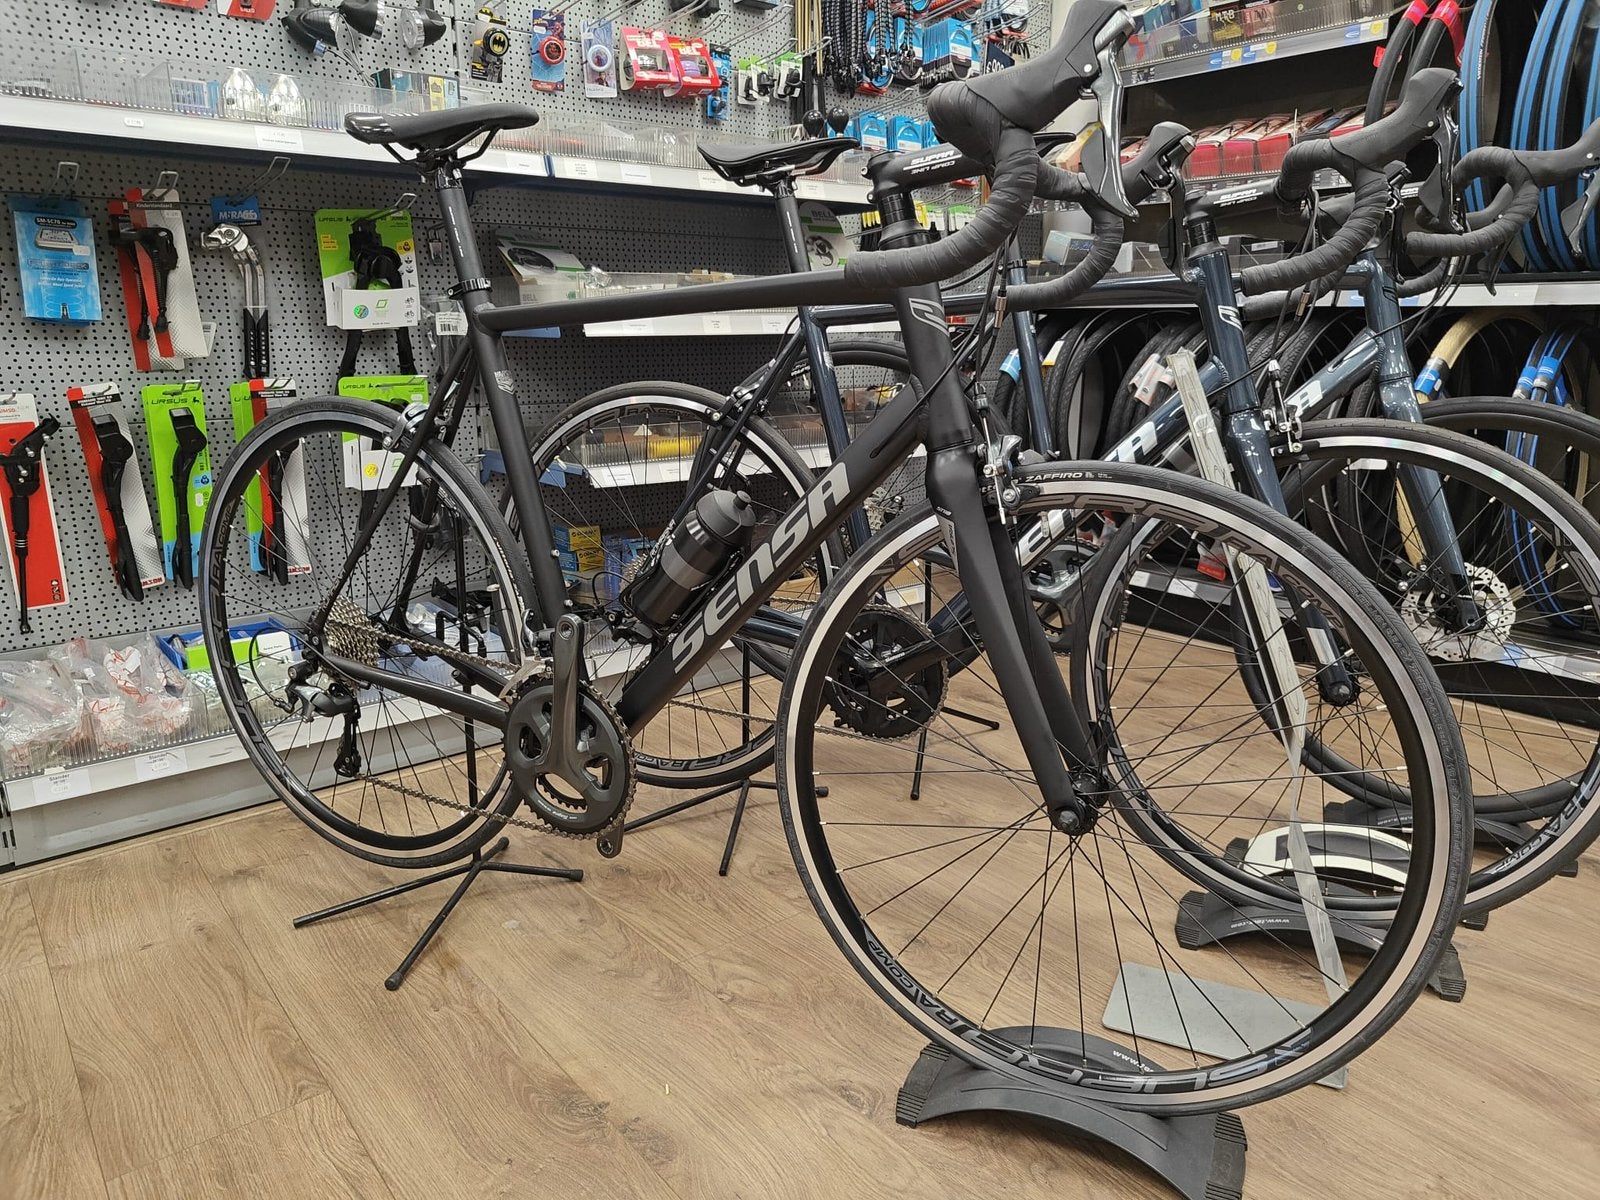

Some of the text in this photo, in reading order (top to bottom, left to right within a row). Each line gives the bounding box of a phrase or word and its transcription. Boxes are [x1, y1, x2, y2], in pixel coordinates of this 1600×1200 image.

[911, 150, 954, 165] SUPRA
[151, 397, 188, 405] URSUS
[1025, 471, 1083, 483] ZAFFIRO
[49, 773, 70, 782] Stander
[868, 938, 915, 988] COMP
